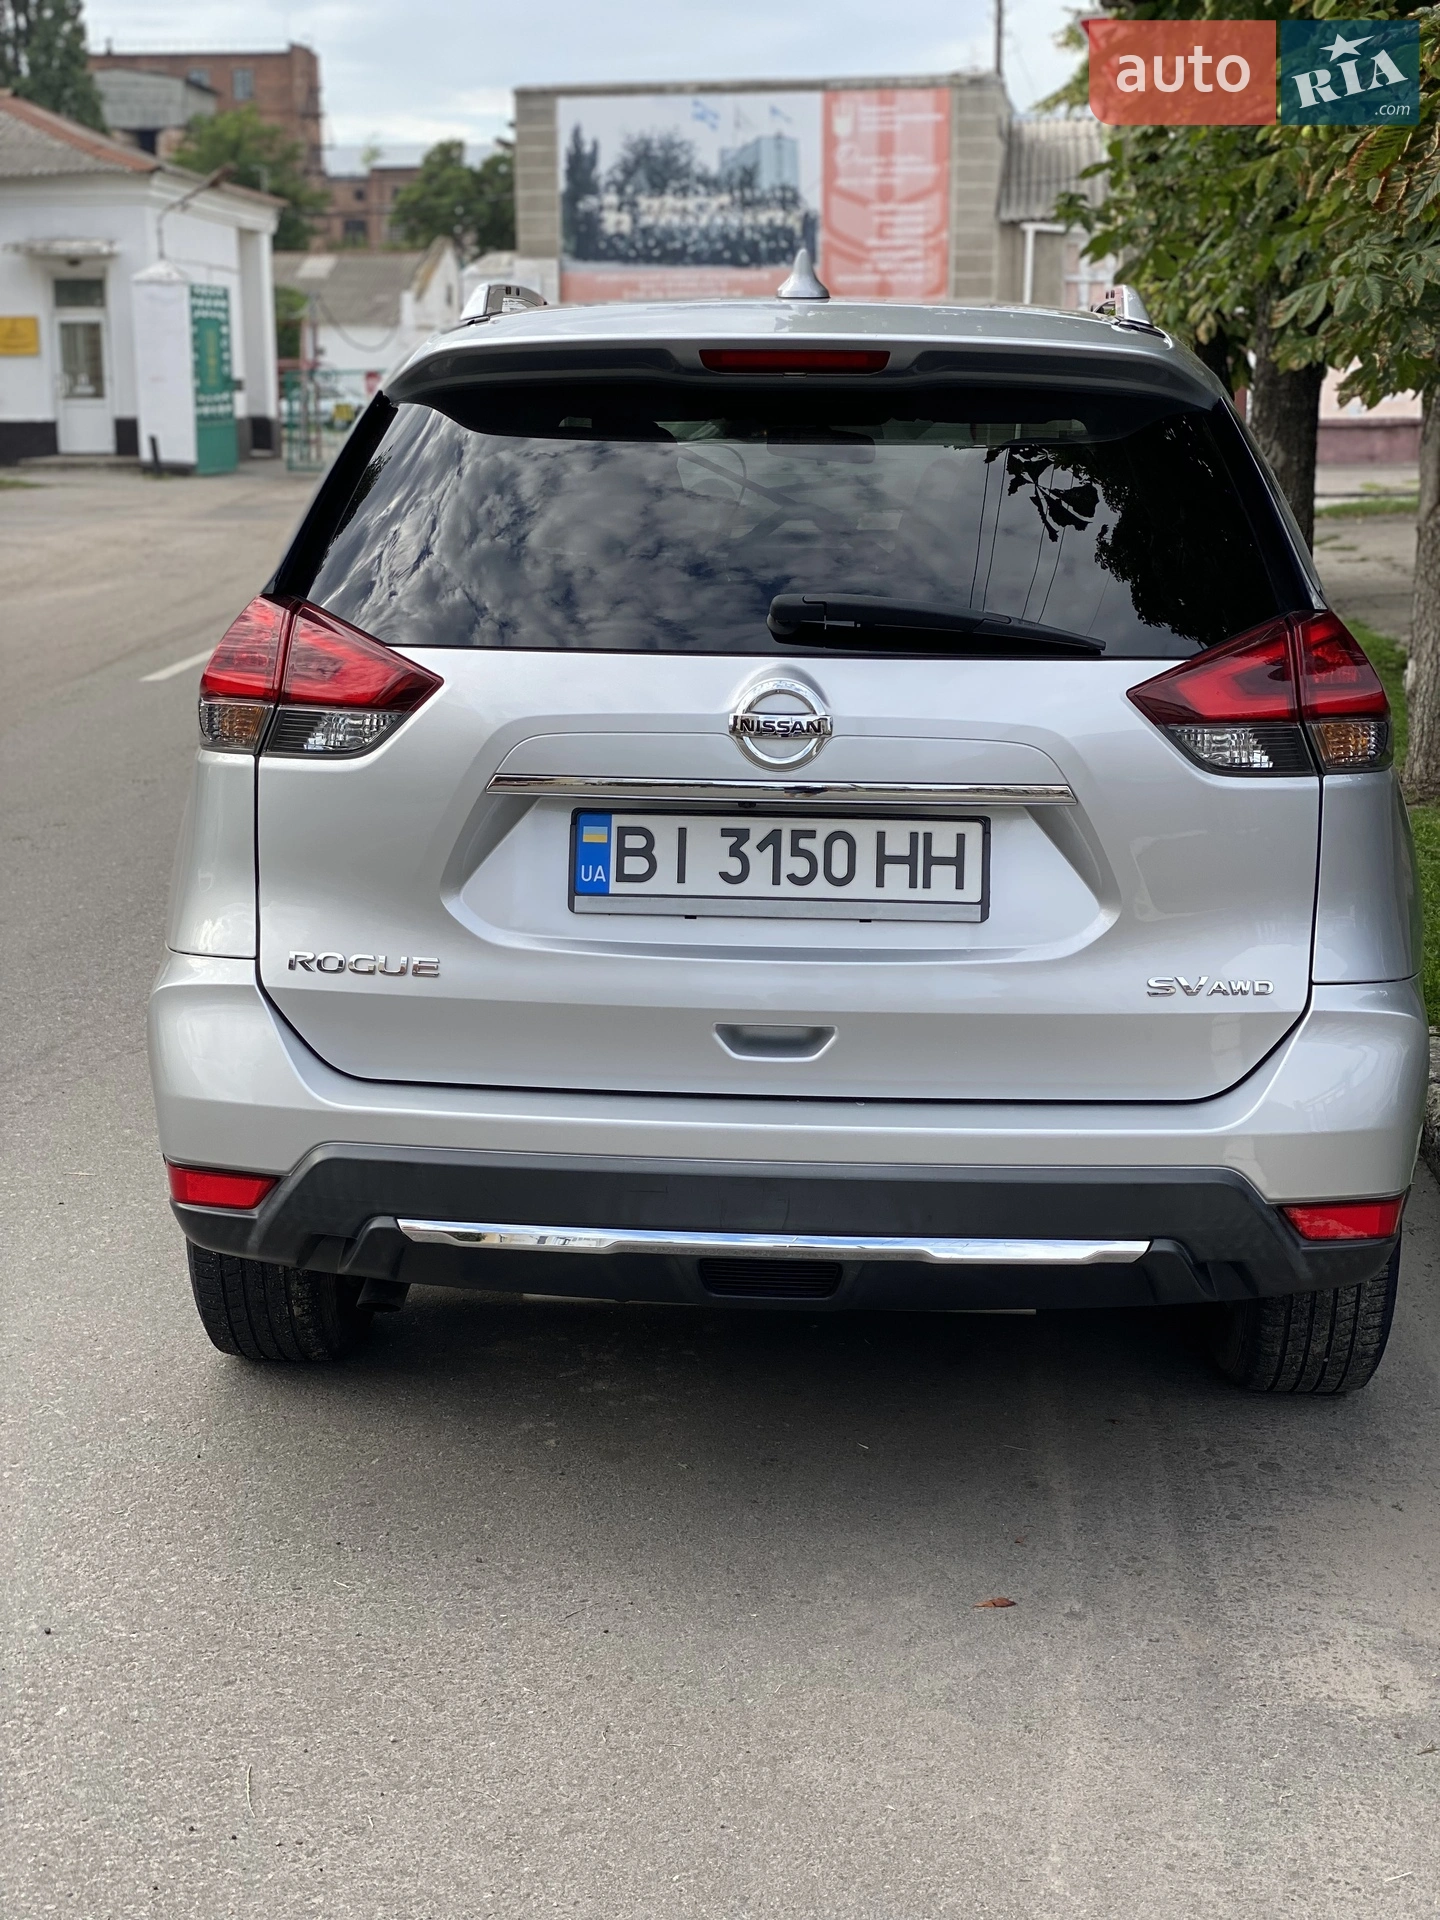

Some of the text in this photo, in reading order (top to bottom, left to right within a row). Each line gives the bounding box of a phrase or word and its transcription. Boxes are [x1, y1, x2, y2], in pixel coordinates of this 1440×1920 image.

[740, 718, 821, 734] NISSAN
[615, 826, 966, 889] BI 3150 HH
[581, 864, 607, 882] UA
[287, 950, 440, 978] ROGUE
[1147, 976, 1275, 997] SV AWD
